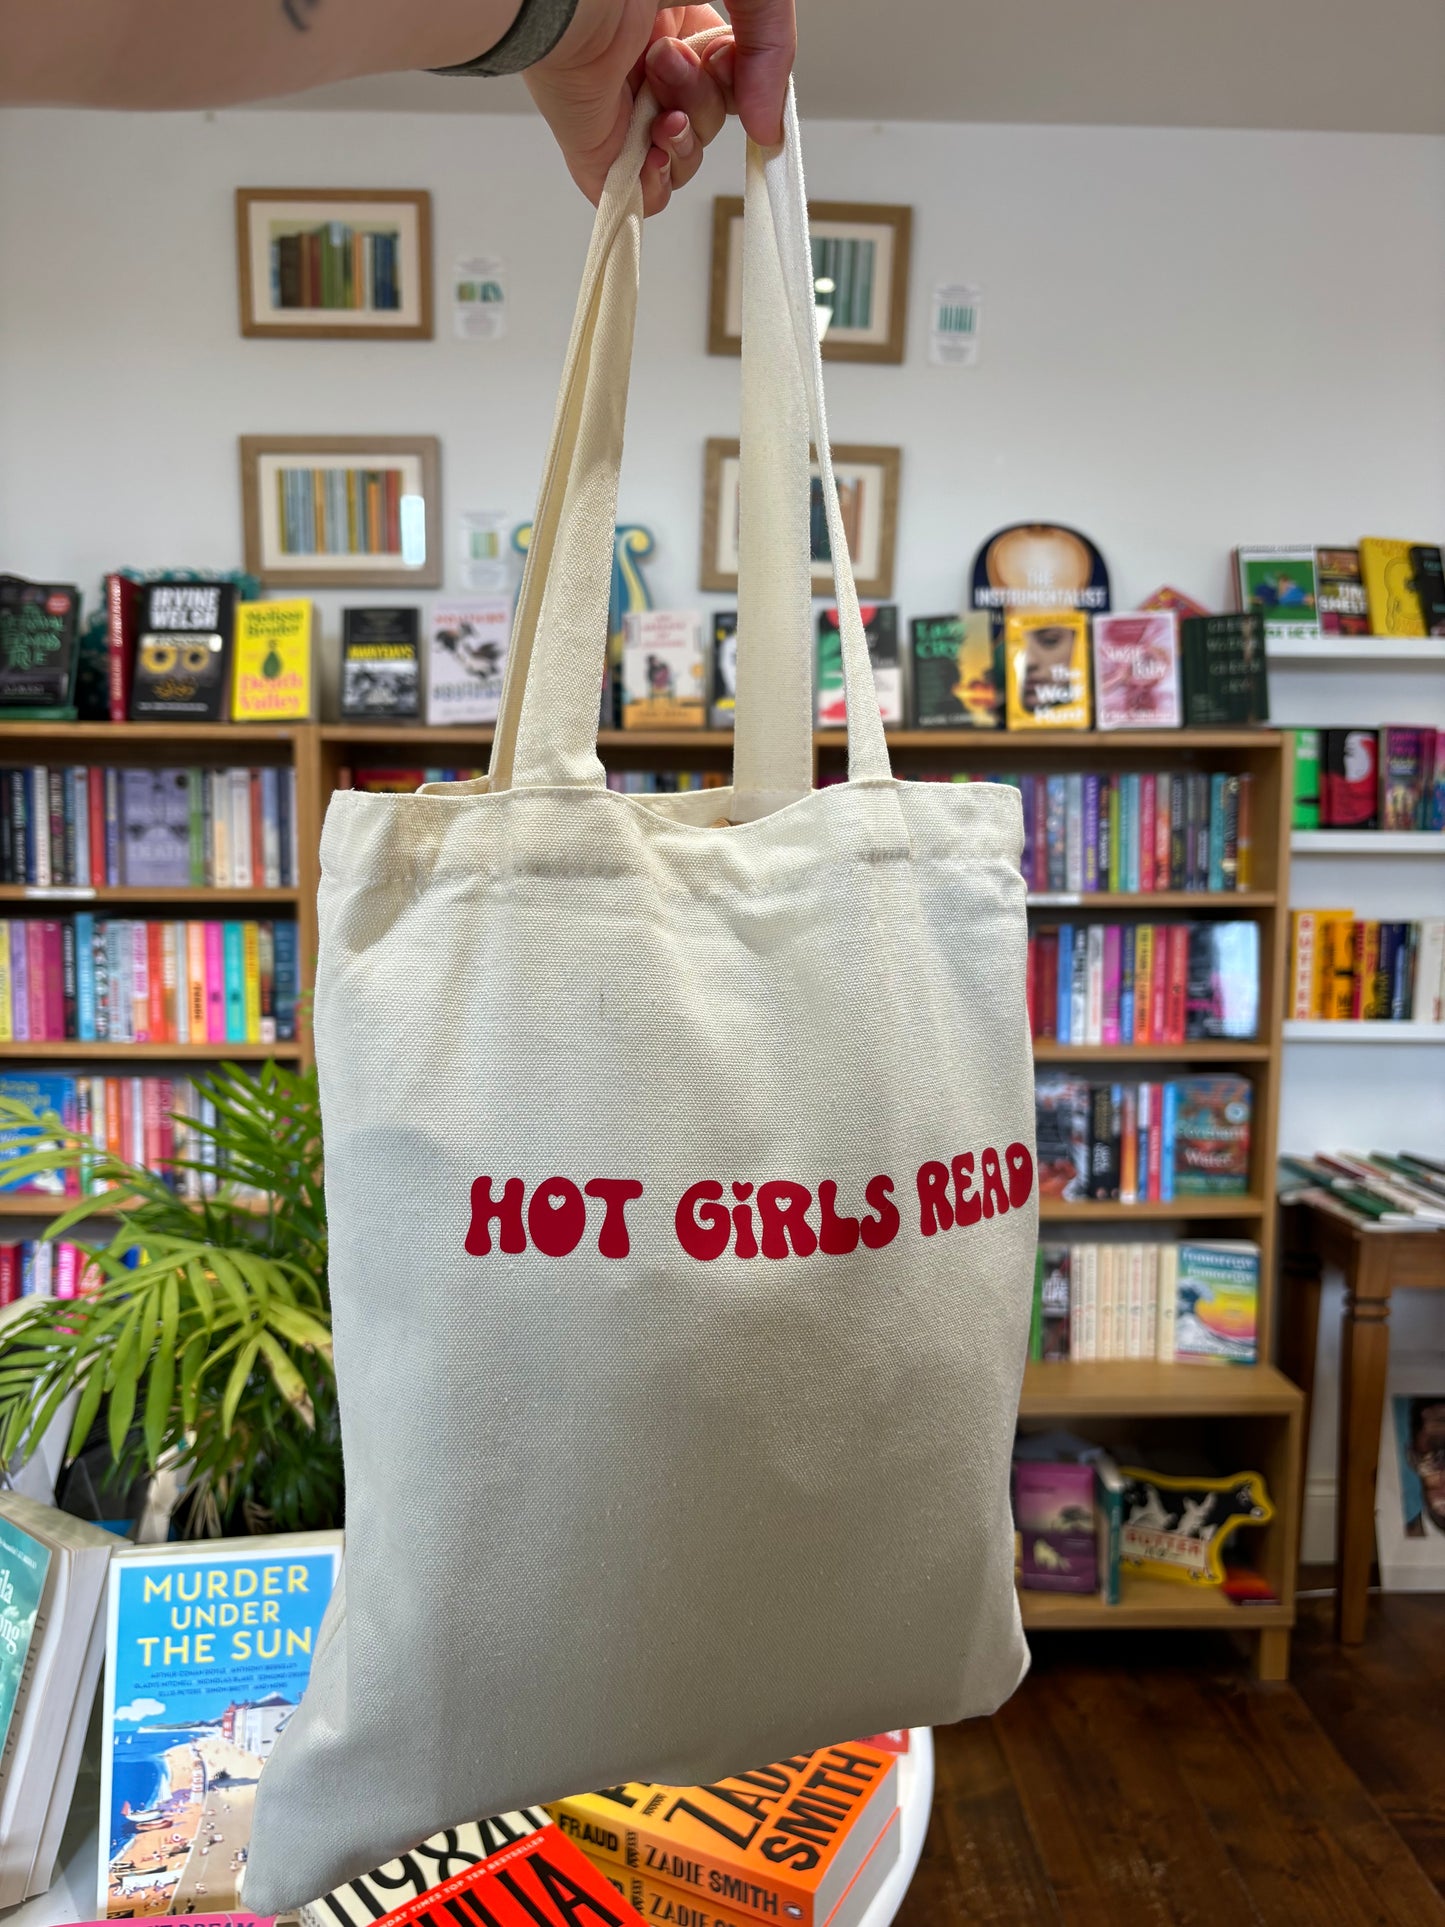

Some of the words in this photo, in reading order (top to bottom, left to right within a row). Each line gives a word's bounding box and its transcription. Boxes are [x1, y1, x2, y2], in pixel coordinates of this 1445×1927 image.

[151, 609, 219, 631] WELSH
[152, 587, 220, 609] IRVINE
[464, 1175, 643, 1259] HOT
[916, 1142, 1033, 1236] READ
[143, 1564, 309, 1603] MURDER
[171, 1600, 280, 1630] UNDER
[137, 1633, 216, 1666] THE
[230, 1626, 311, 1660] SUN
[664, 1750, 816, 1850] ZAD
[760, 1748, 882, 1871] SMITH
[410, 1892, 442, 1912] TIMES
[443, 1879, 465, 1894] TOP
[465, 1867, 487, 1881] TEN
[486, 1835, 545, 1870] BESTSELLER
[559, 1813, 619, 1852] FRAUD
[645, 1844, 705, 1887] ZADIE
[708, 1869, 778, 1916] SMITH
